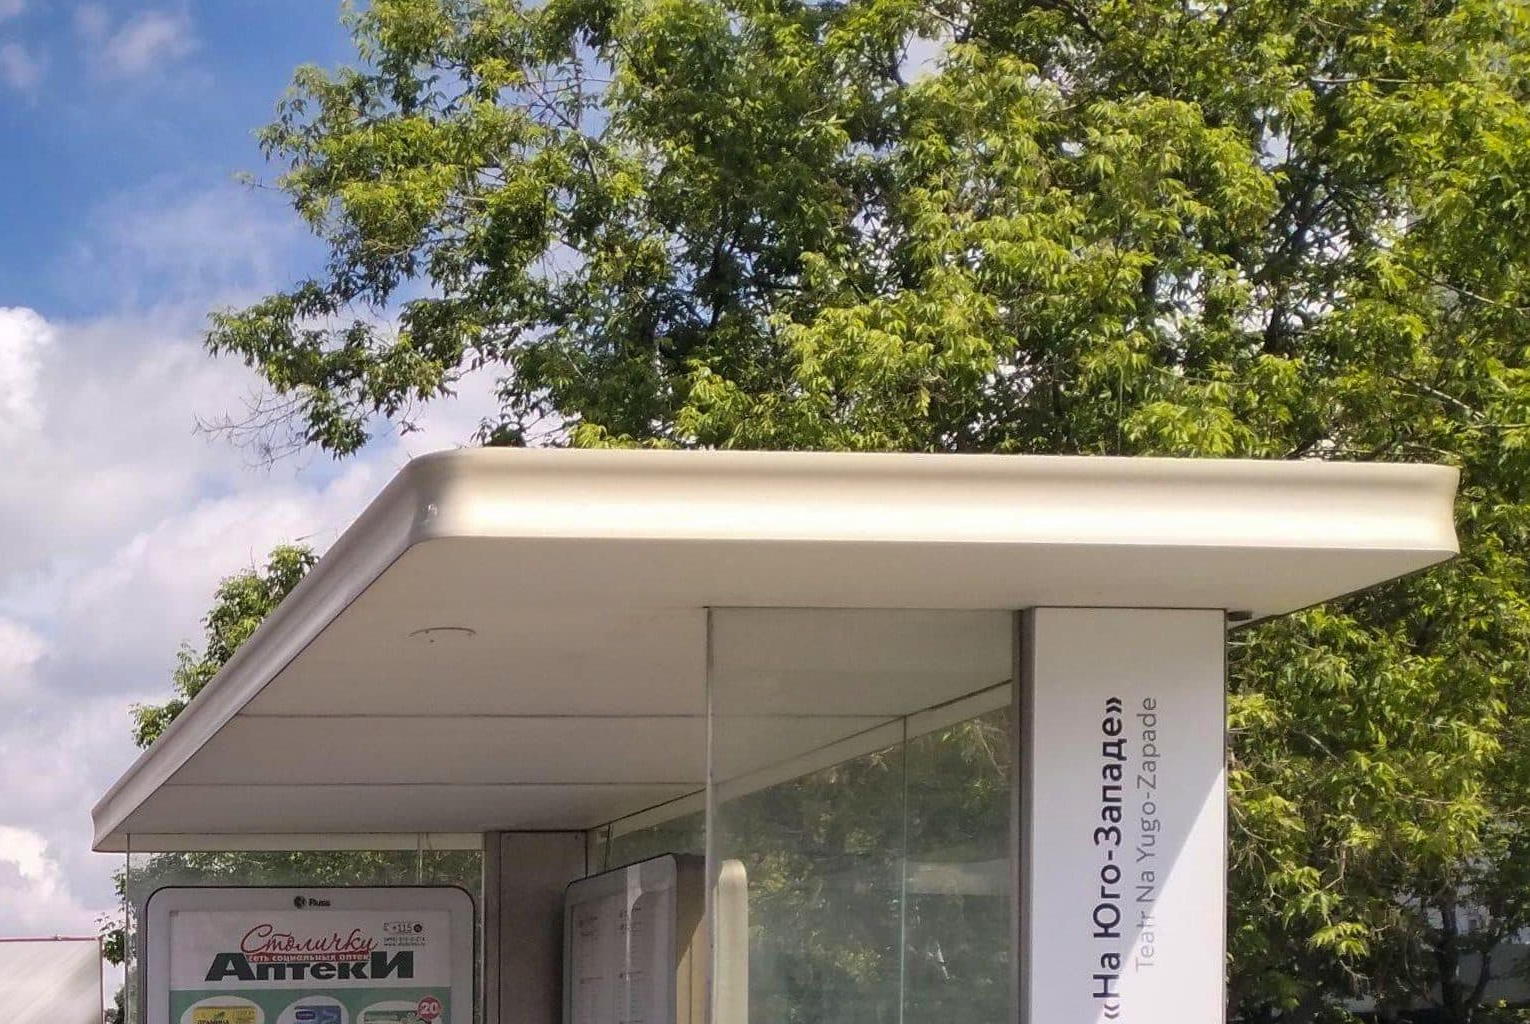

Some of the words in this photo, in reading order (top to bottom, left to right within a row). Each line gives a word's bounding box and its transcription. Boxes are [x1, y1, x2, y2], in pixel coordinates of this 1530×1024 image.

[1136, 697, 1160, 860] Yugo-Zapade
[1093, 696, 1128, 938] Юго-Западе»
[1136, 870, 1156, 897] Na
[1136, 909, 1155, 972] Teatr
[1092, 952, 1121, 1020] «На
